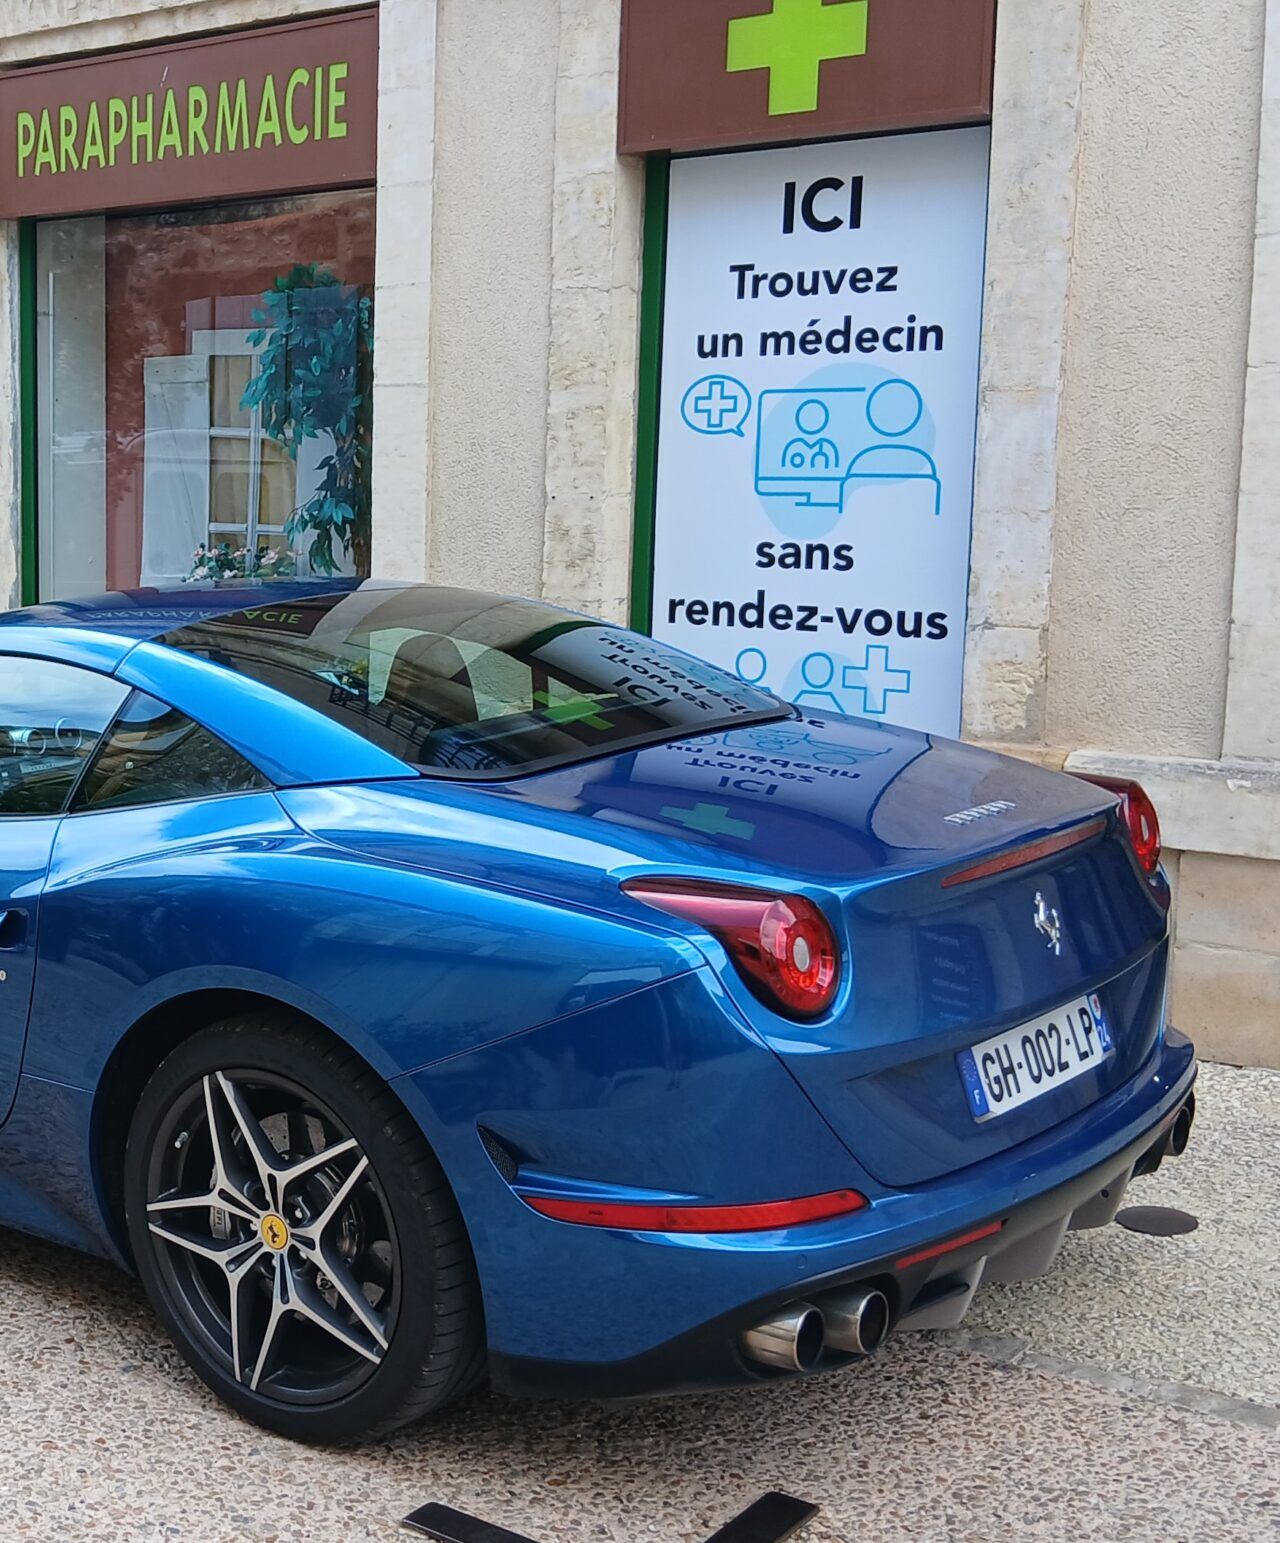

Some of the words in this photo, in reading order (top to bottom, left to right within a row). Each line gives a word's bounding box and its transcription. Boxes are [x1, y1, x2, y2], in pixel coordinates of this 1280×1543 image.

[16, 62, 348, 178] PARAPHARMACIE
[782, 175, 864, 234] ICI
[729, 263, 898, 299] Trouvez
[697, 331, 743, 359] un
[759, 314, 943, 356] médecin
[755, 541, 854, 571] sans
[668, 589, 948, 640] rendez-vous
[981, 1006, 1094, 1103] GH-002-LP
[1097, 1021, 1111, 1047] 24
[973, 1089, 980, 1104] F
